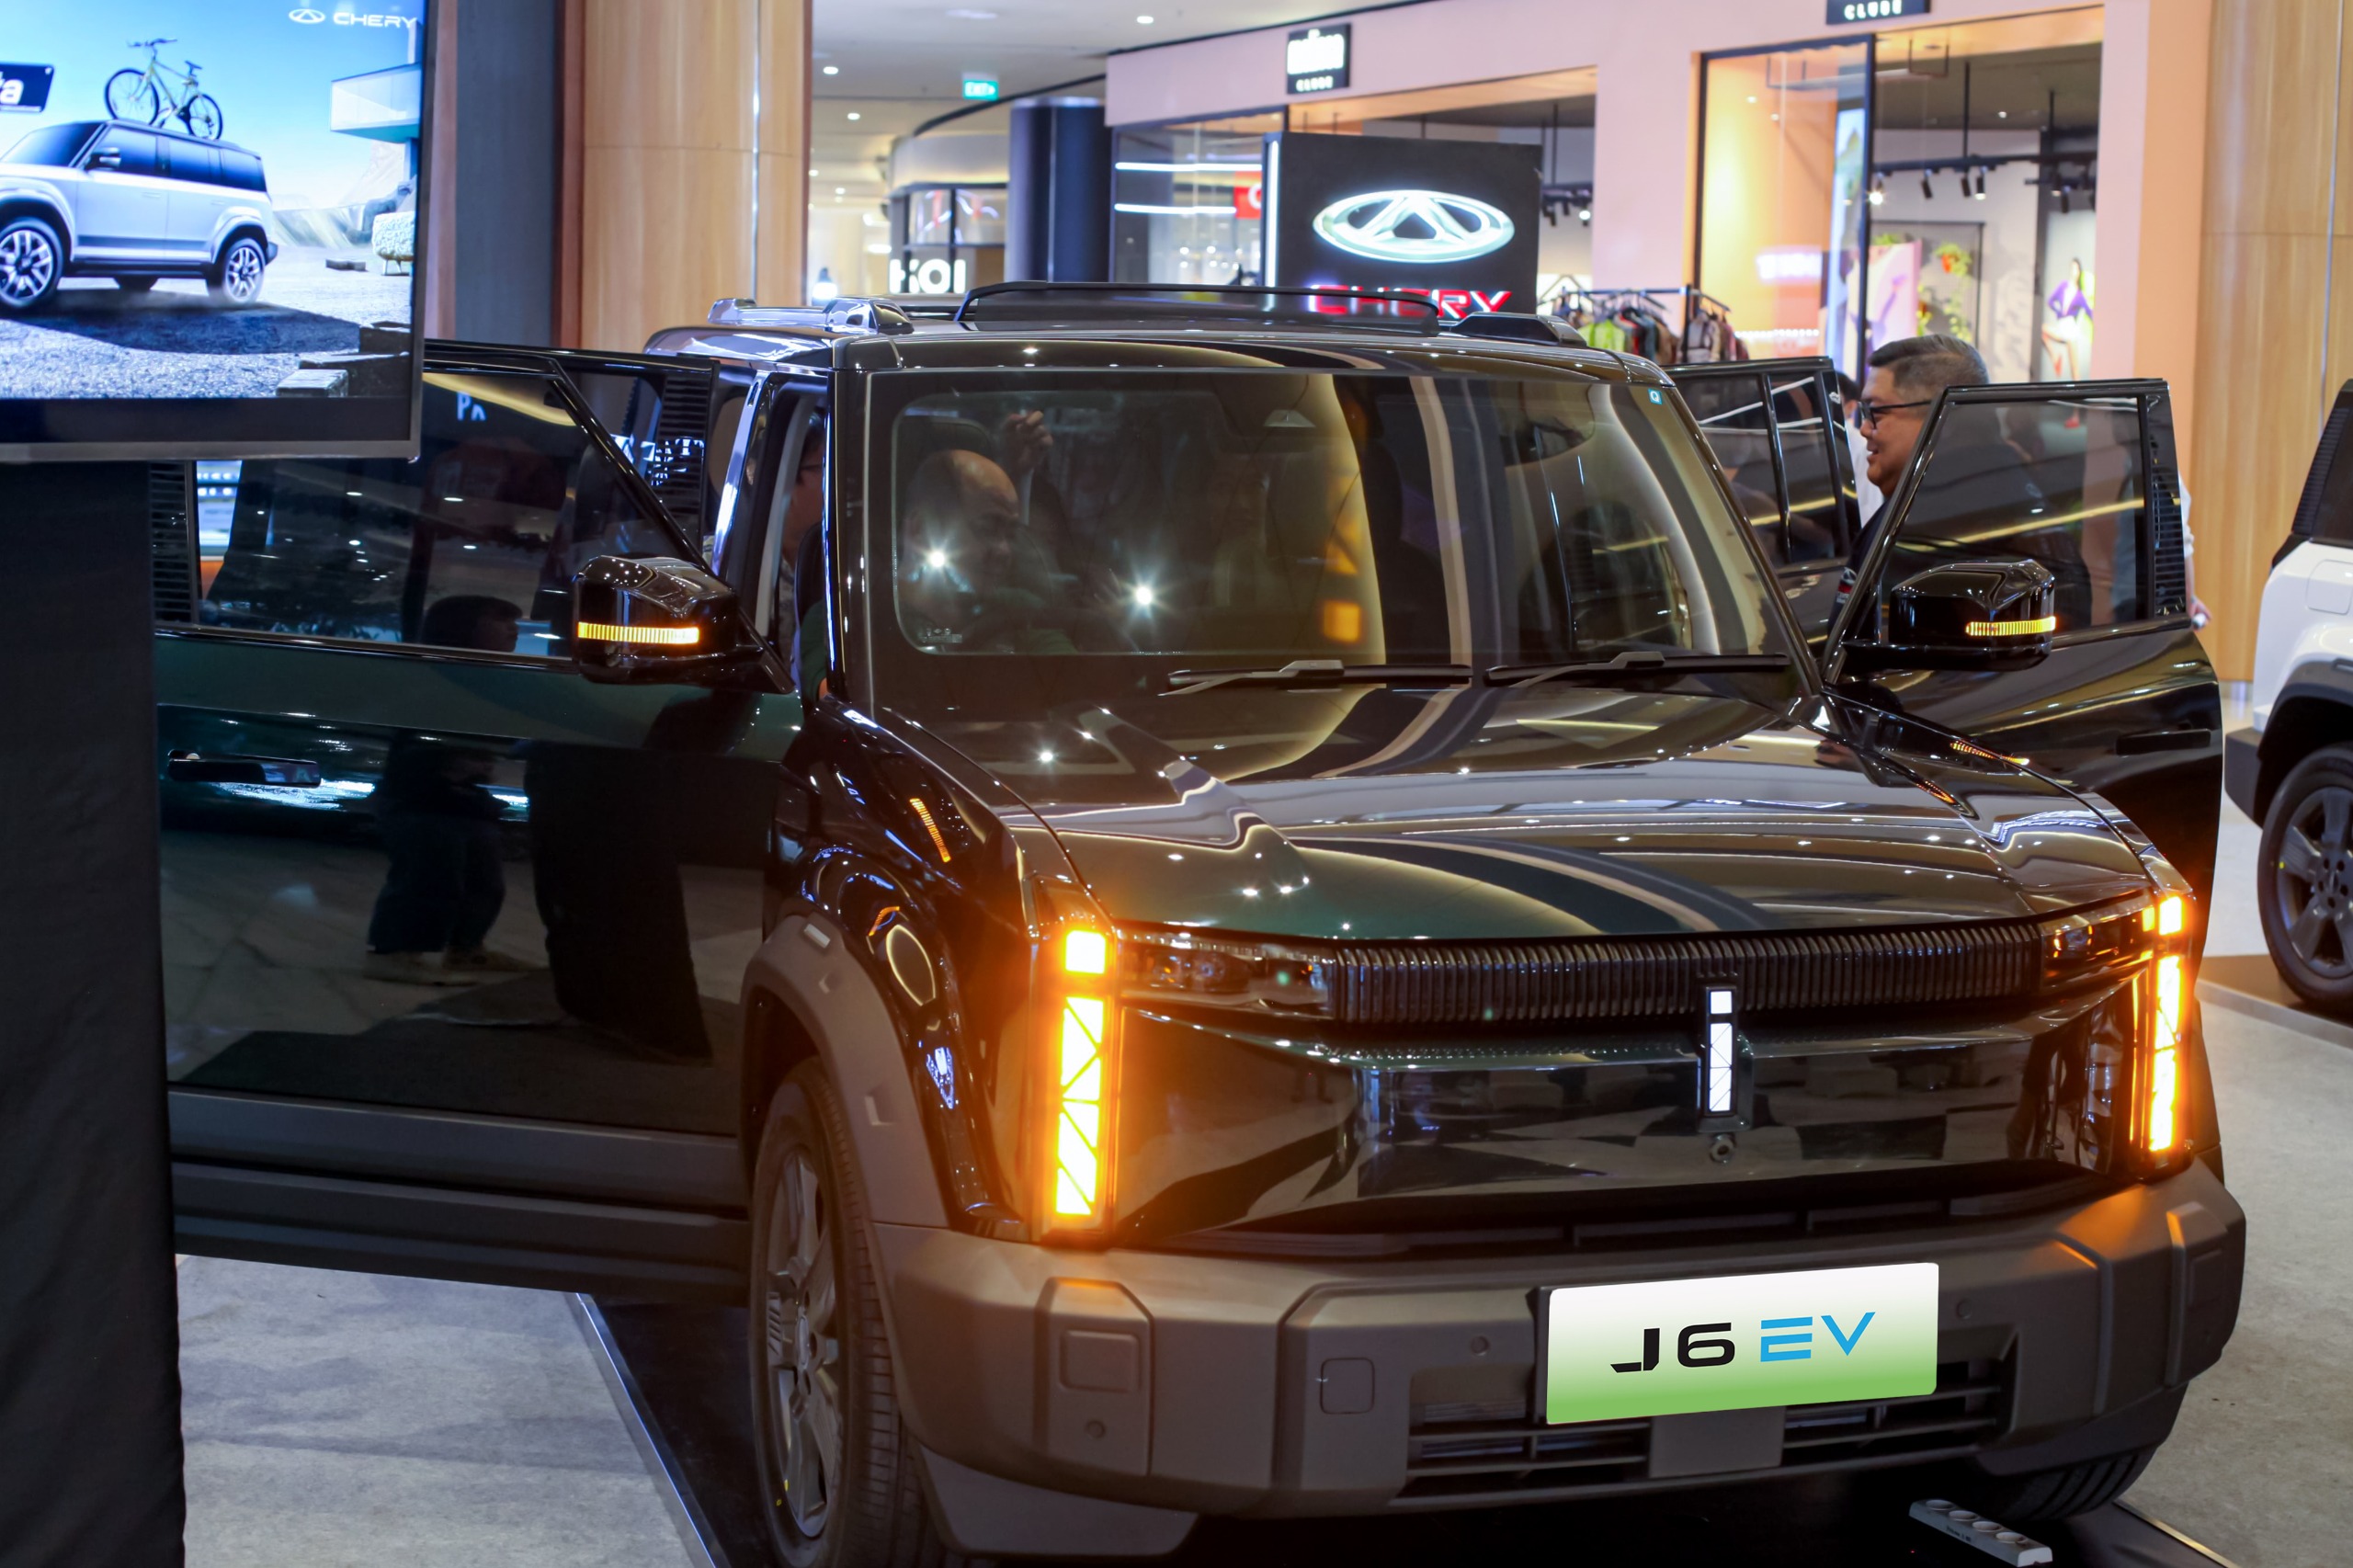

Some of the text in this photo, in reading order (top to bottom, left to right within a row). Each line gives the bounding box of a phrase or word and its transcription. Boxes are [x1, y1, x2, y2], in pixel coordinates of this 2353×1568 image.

[333, 12, 417, 28] CHERY
[1307, 284, 1513, 320] CHERY
[1609, 1312, 1876, 1373] J6 EV
